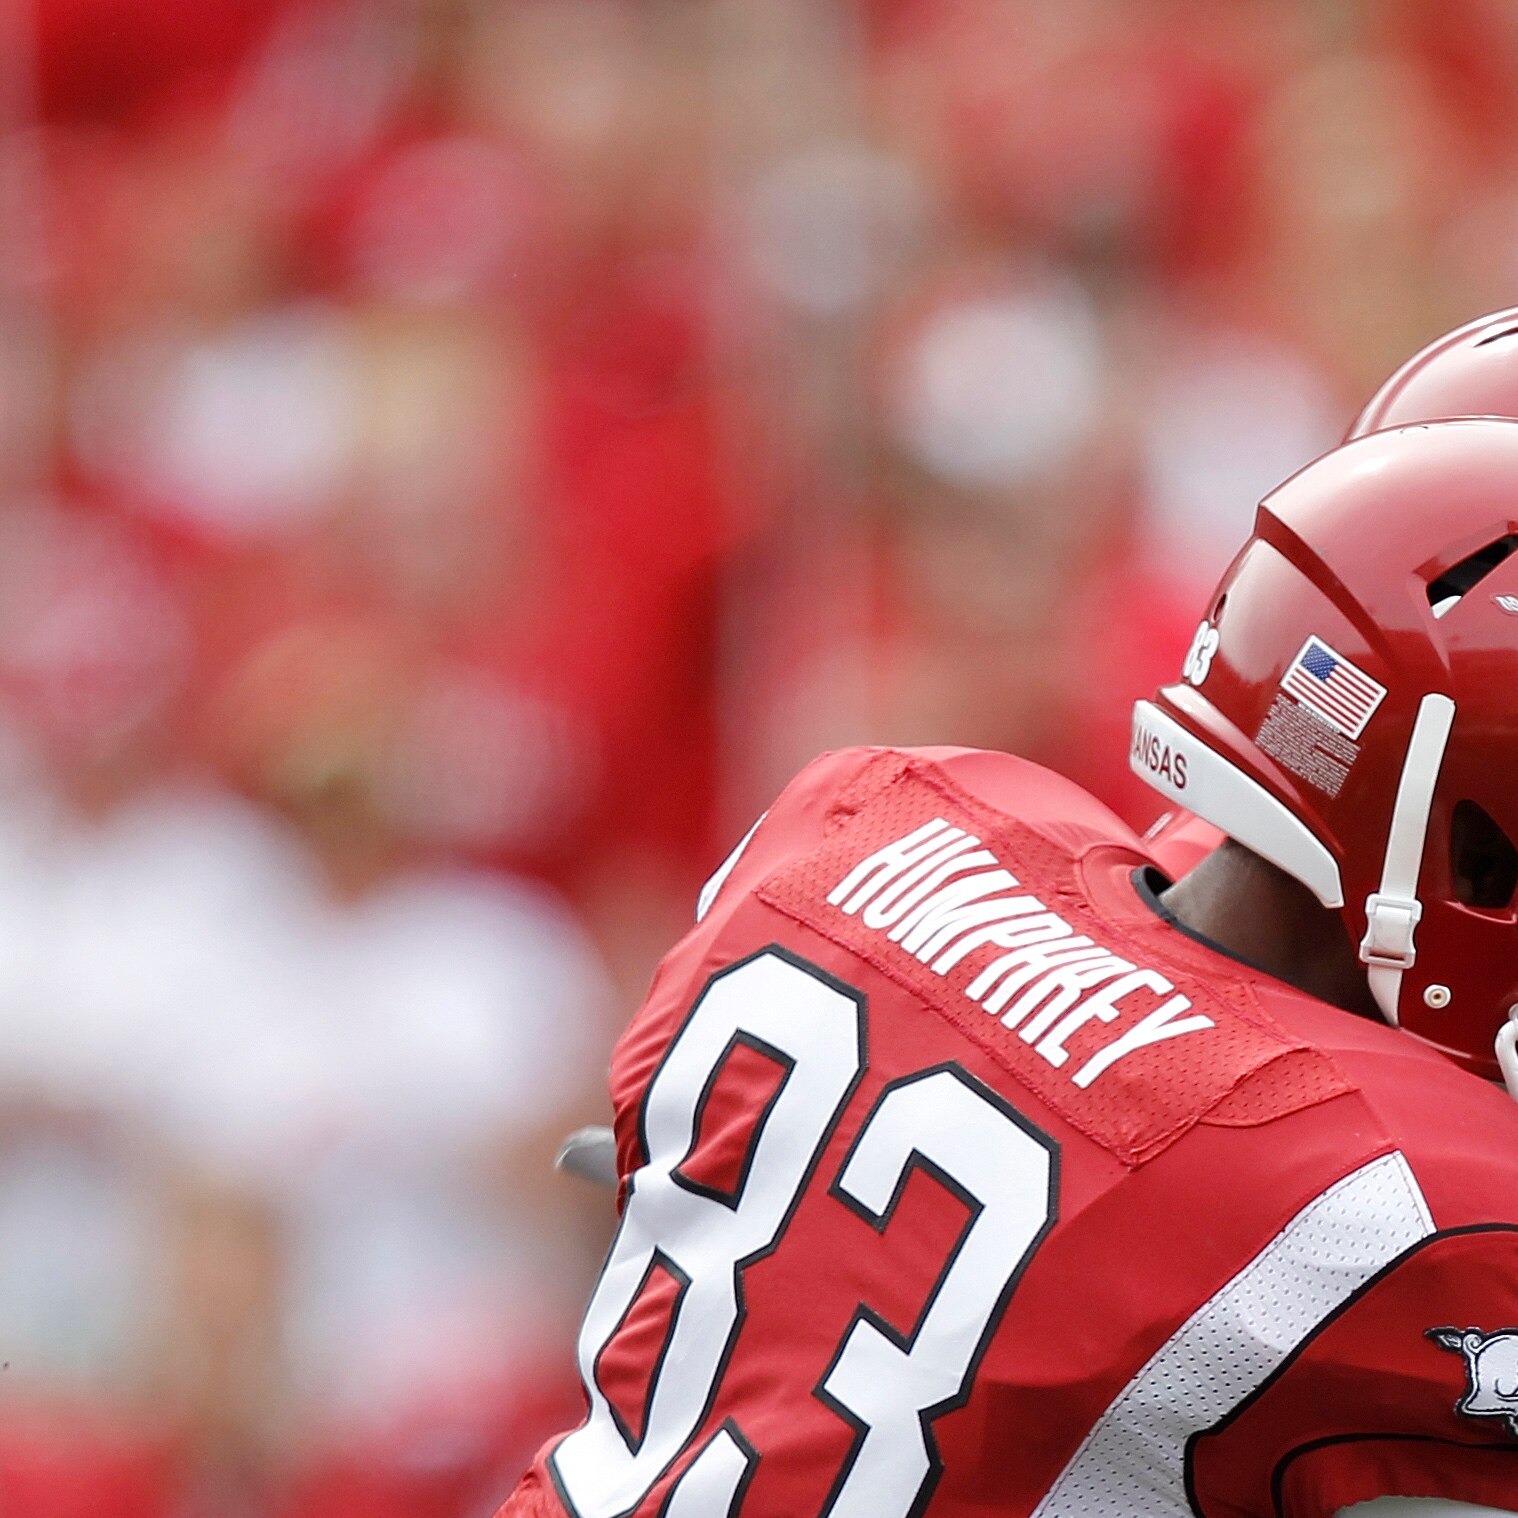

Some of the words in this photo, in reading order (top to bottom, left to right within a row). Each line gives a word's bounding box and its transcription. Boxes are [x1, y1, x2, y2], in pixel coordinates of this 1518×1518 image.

[1182, 619, 1221, 687] 83
[1131, 724, 1188, 790] ANSAS
[826, 817, 1215, 1090] HUMPHREY
